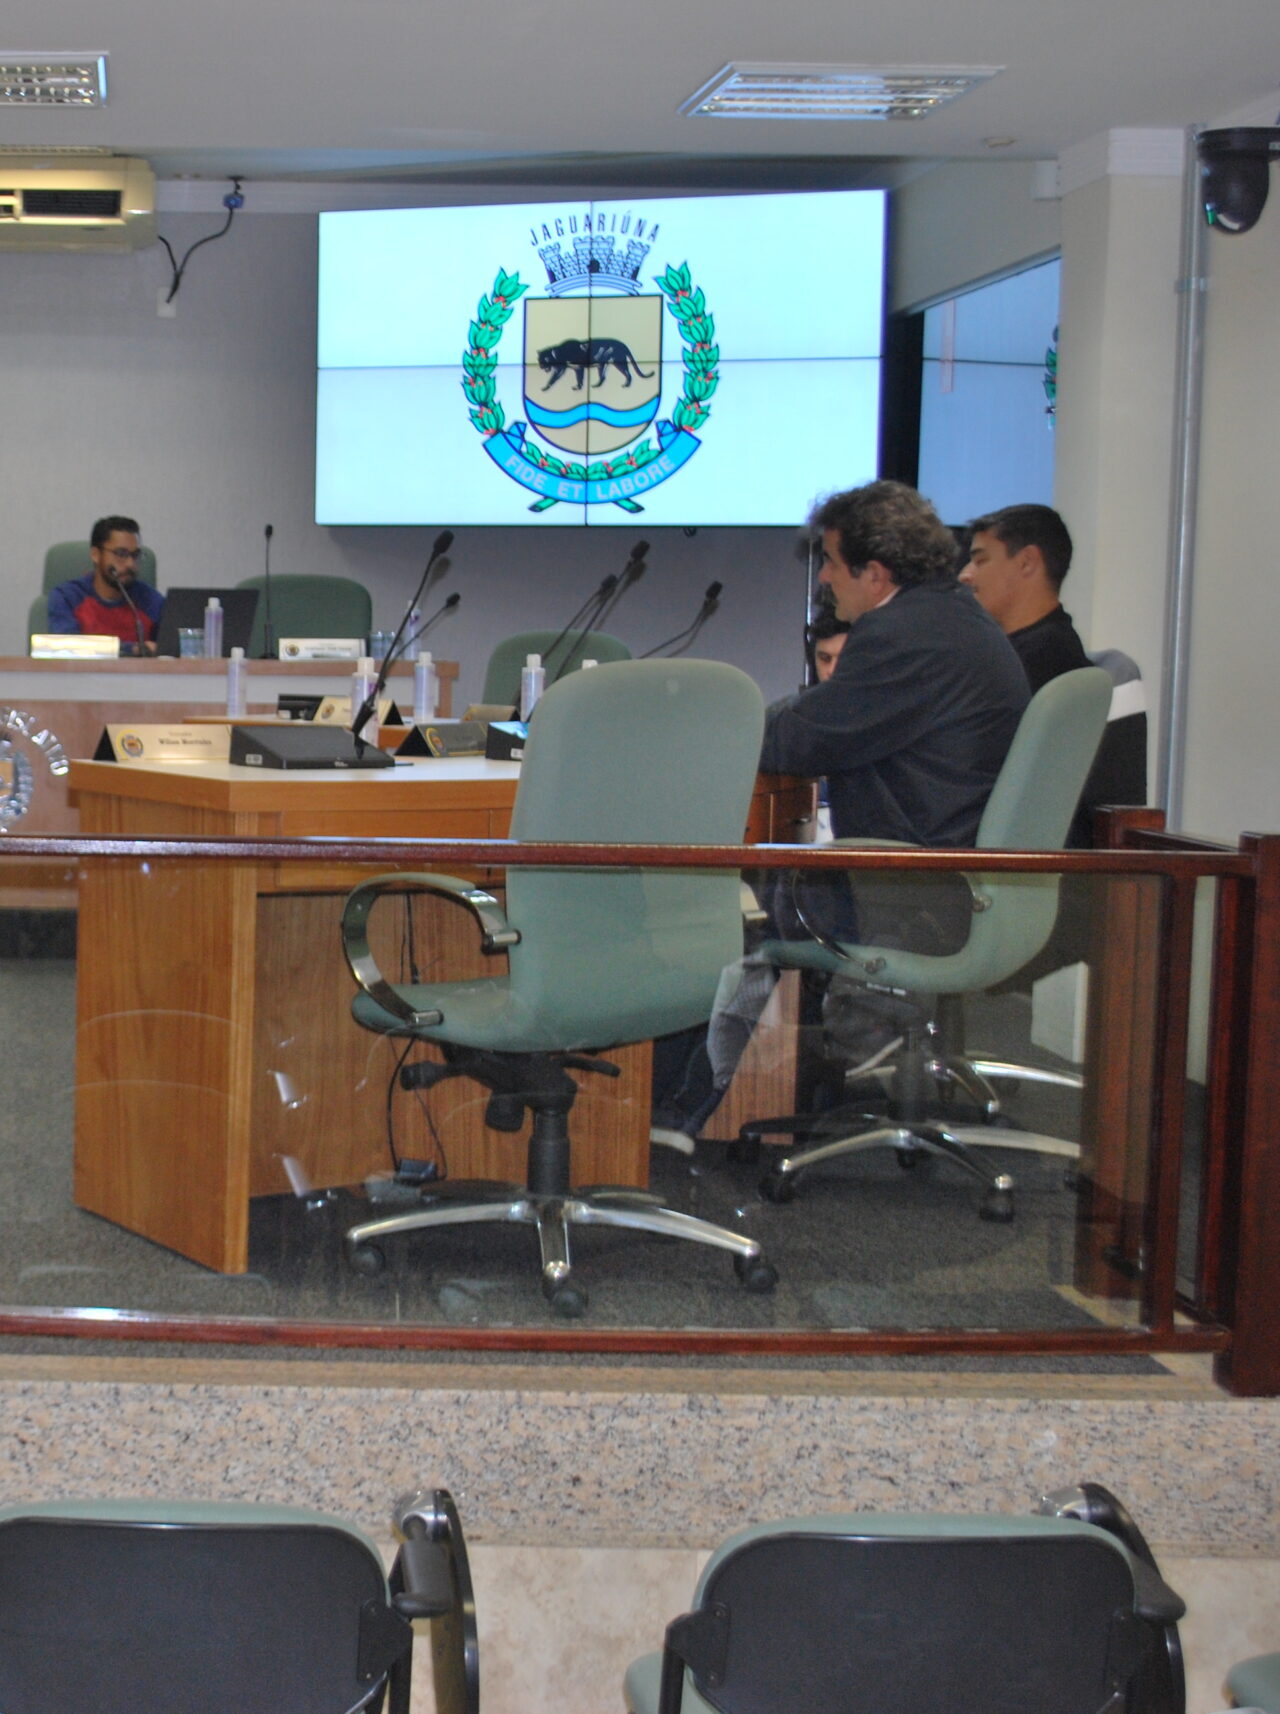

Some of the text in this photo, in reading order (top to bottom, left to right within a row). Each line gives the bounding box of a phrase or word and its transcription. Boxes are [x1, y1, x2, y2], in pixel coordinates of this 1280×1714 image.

[530, 209, 660, 247] JAGUARIÚNA
[505, 454, 676, 500] FIDE ET LABORE
